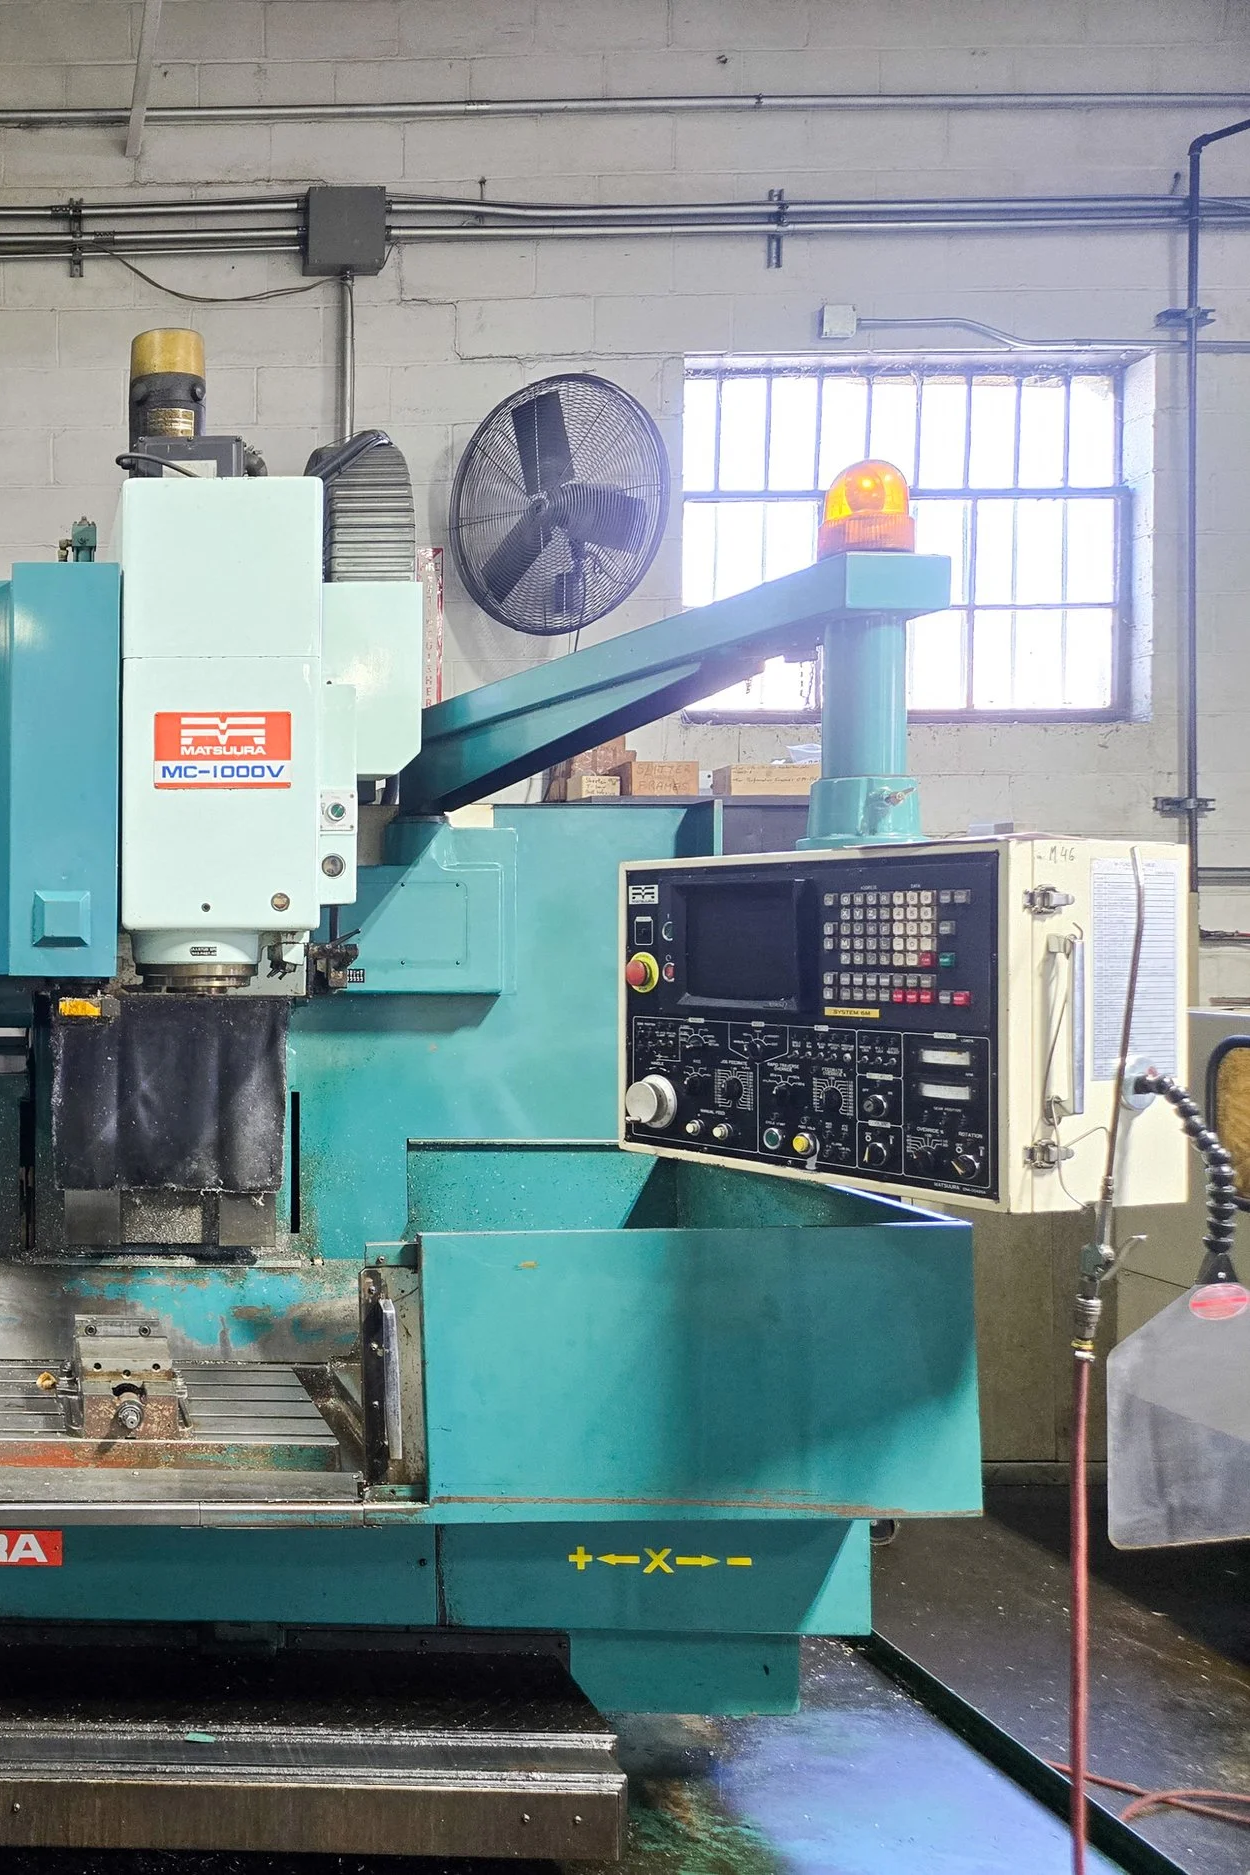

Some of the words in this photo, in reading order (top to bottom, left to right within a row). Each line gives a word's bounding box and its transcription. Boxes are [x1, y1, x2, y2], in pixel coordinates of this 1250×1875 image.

[180, 745, 267, 756] MATSUURA
[161, 765, 285, 779] MC-1000V
[958, 1131, 983, 1139] ROTATION
[933, 1182, 960, 1190] MATSUURA
[642, 1548, 675, 1574] X
